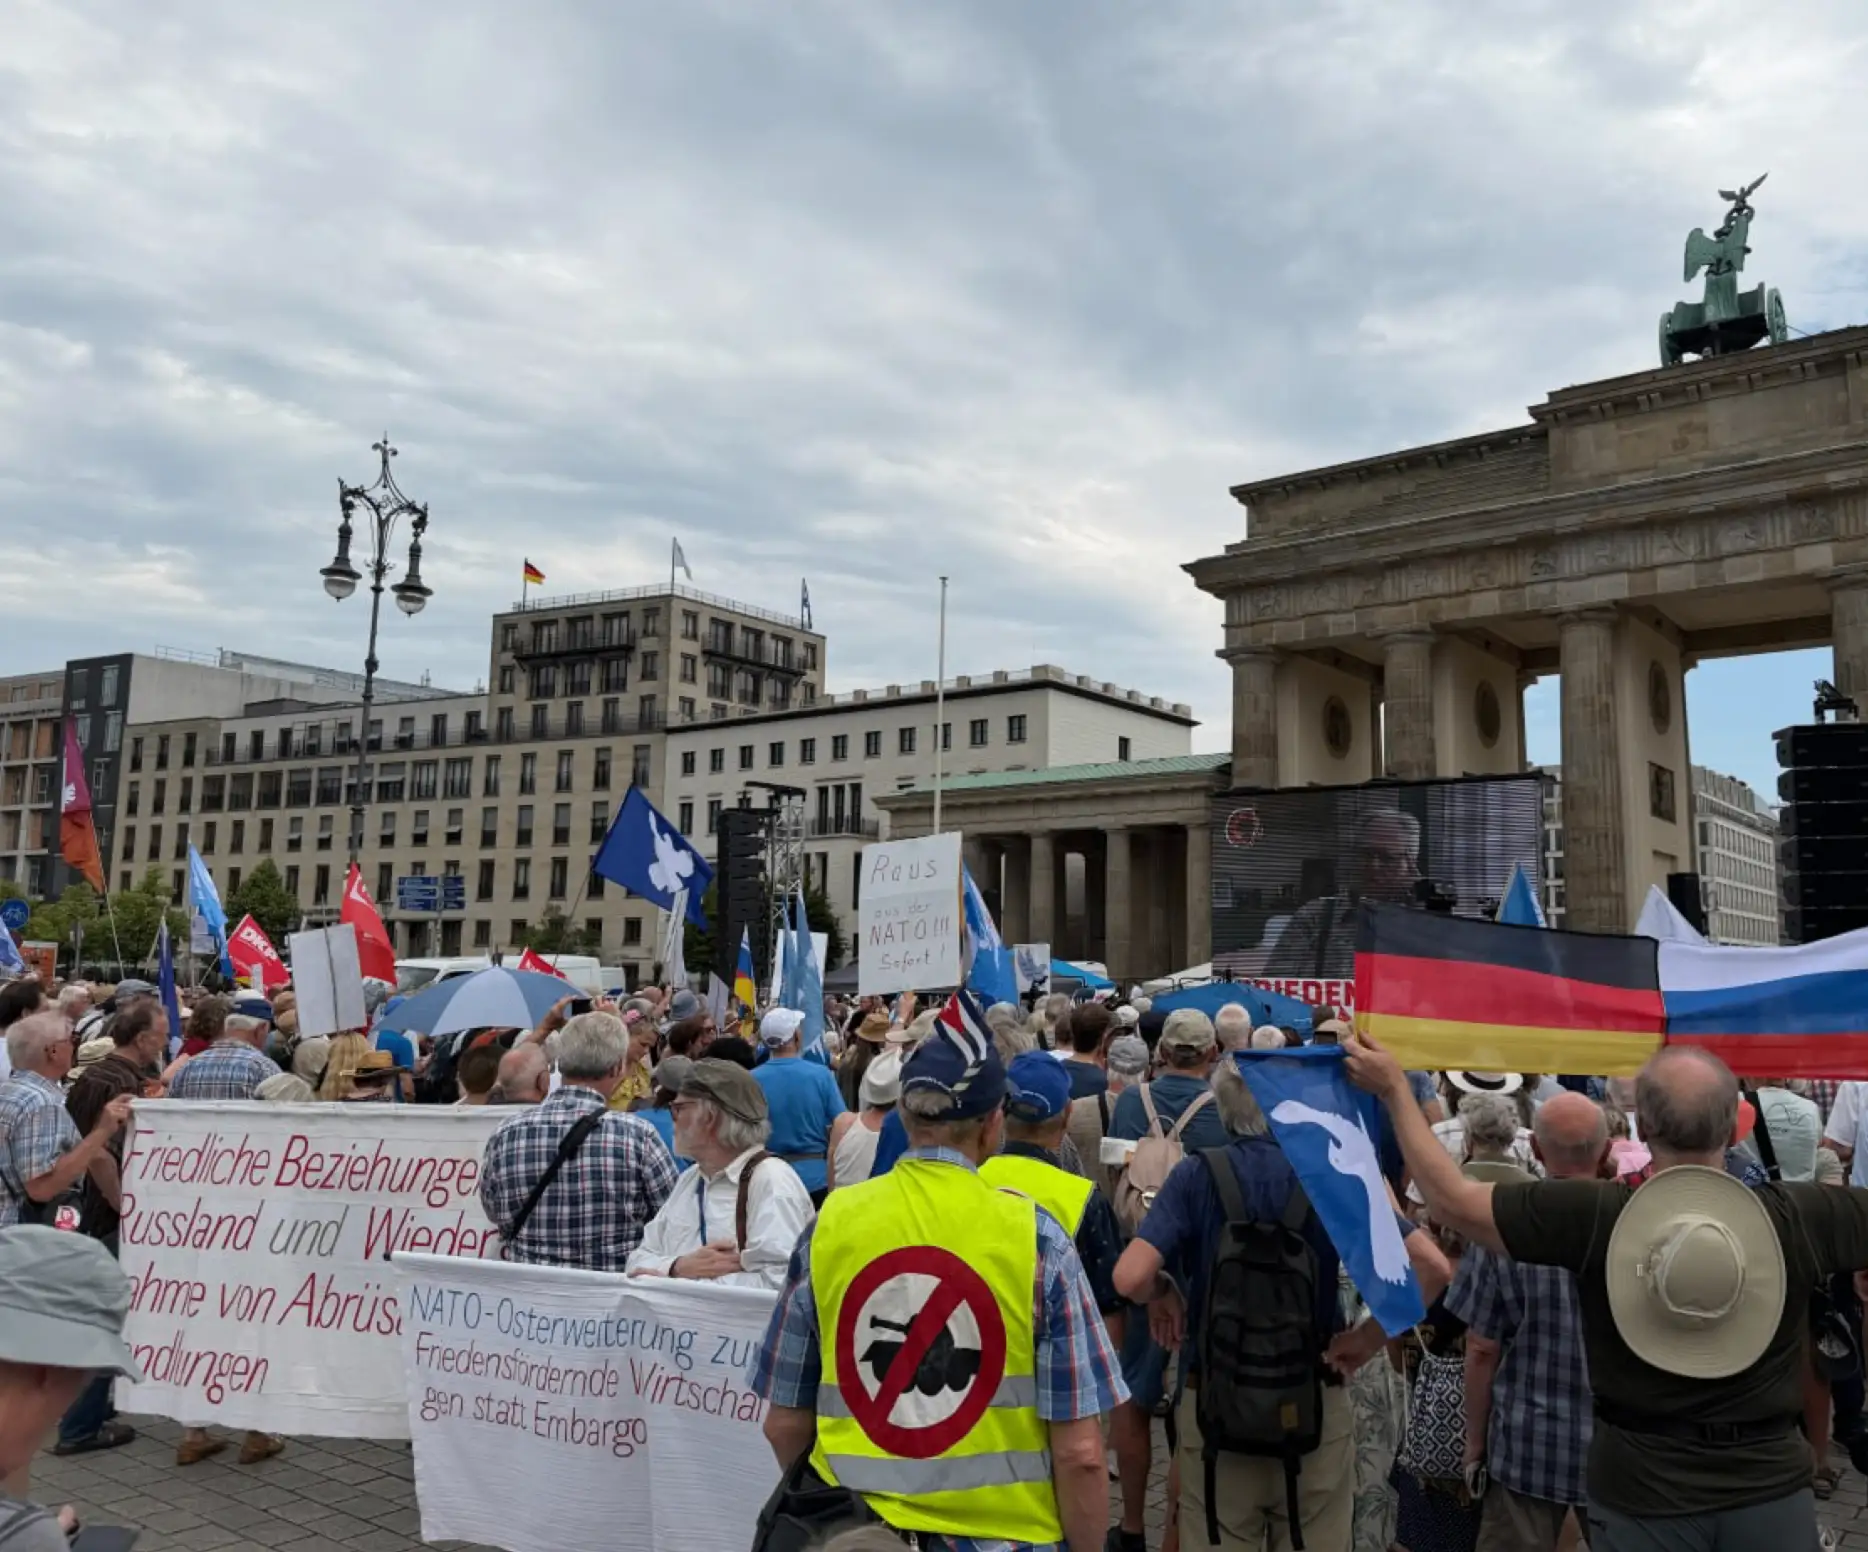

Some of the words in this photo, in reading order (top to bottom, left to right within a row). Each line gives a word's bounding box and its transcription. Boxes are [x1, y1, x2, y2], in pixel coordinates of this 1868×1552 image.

[871, 854, 938, 885] Raus
[240, 926, 279, 961] DKP
[122, 1129, 271, 1187] Friedliche
[274, 1134, 481, 1208] Beziehunge
[119, 1193, 265, 1252] Russland
[269, 1204, 349, 1258] und
[220, 1282, 277, 1324] von
[408, 1285, 699, 1371] NATO-Osterweiterung
[710, 1335, 757, 1368] zu
[415, 1331, 620, 1398] Friedensfördernde
[420, 1386, 464, 1422] gen
[472, 1388, 528, 1430] statt
[534, 1400, 648, 1459] Embargo
